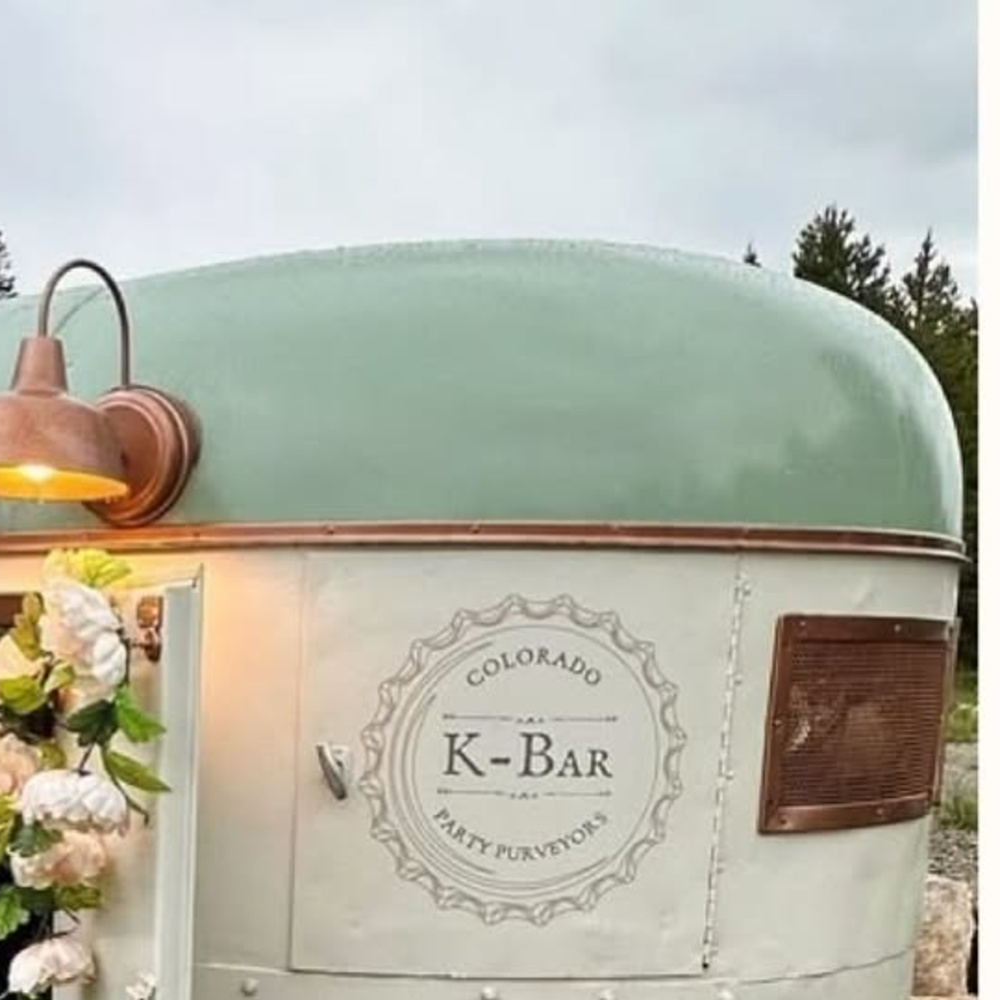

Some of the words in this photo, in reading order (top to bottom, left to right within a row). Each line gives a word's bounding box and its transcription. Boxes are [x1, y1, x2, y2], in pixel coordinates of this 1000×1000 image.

[465, 646, 602, 688] COLORADO
[432, 808, 493, 856] PARTY
[495, 811, 608, 862] PURVEYORS
